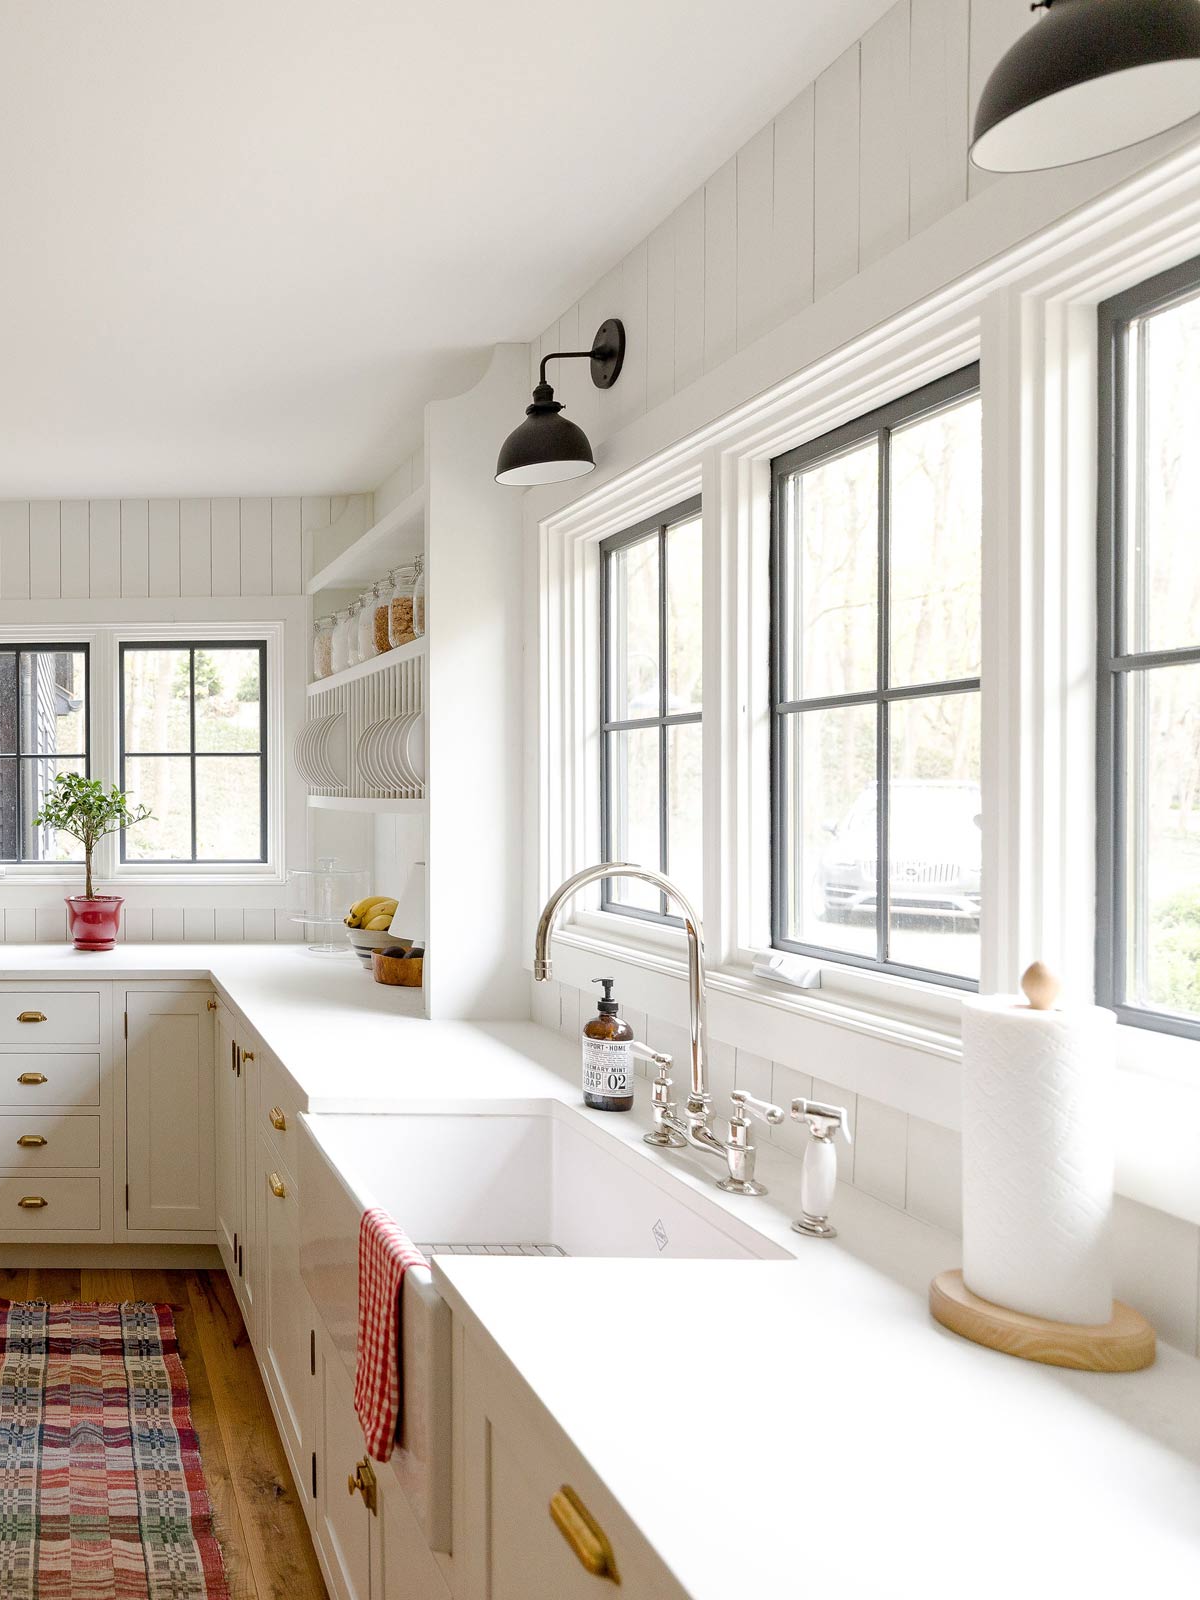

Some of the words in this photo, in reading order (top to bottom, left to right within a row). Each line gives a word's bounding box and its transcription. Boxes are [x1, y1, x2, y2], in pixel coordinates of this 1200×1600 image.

[586, 1064, 609, 1072] SEMARY
[584, 1070, 601, 1080] AND
[607, 1074, 626, 1090] 02
